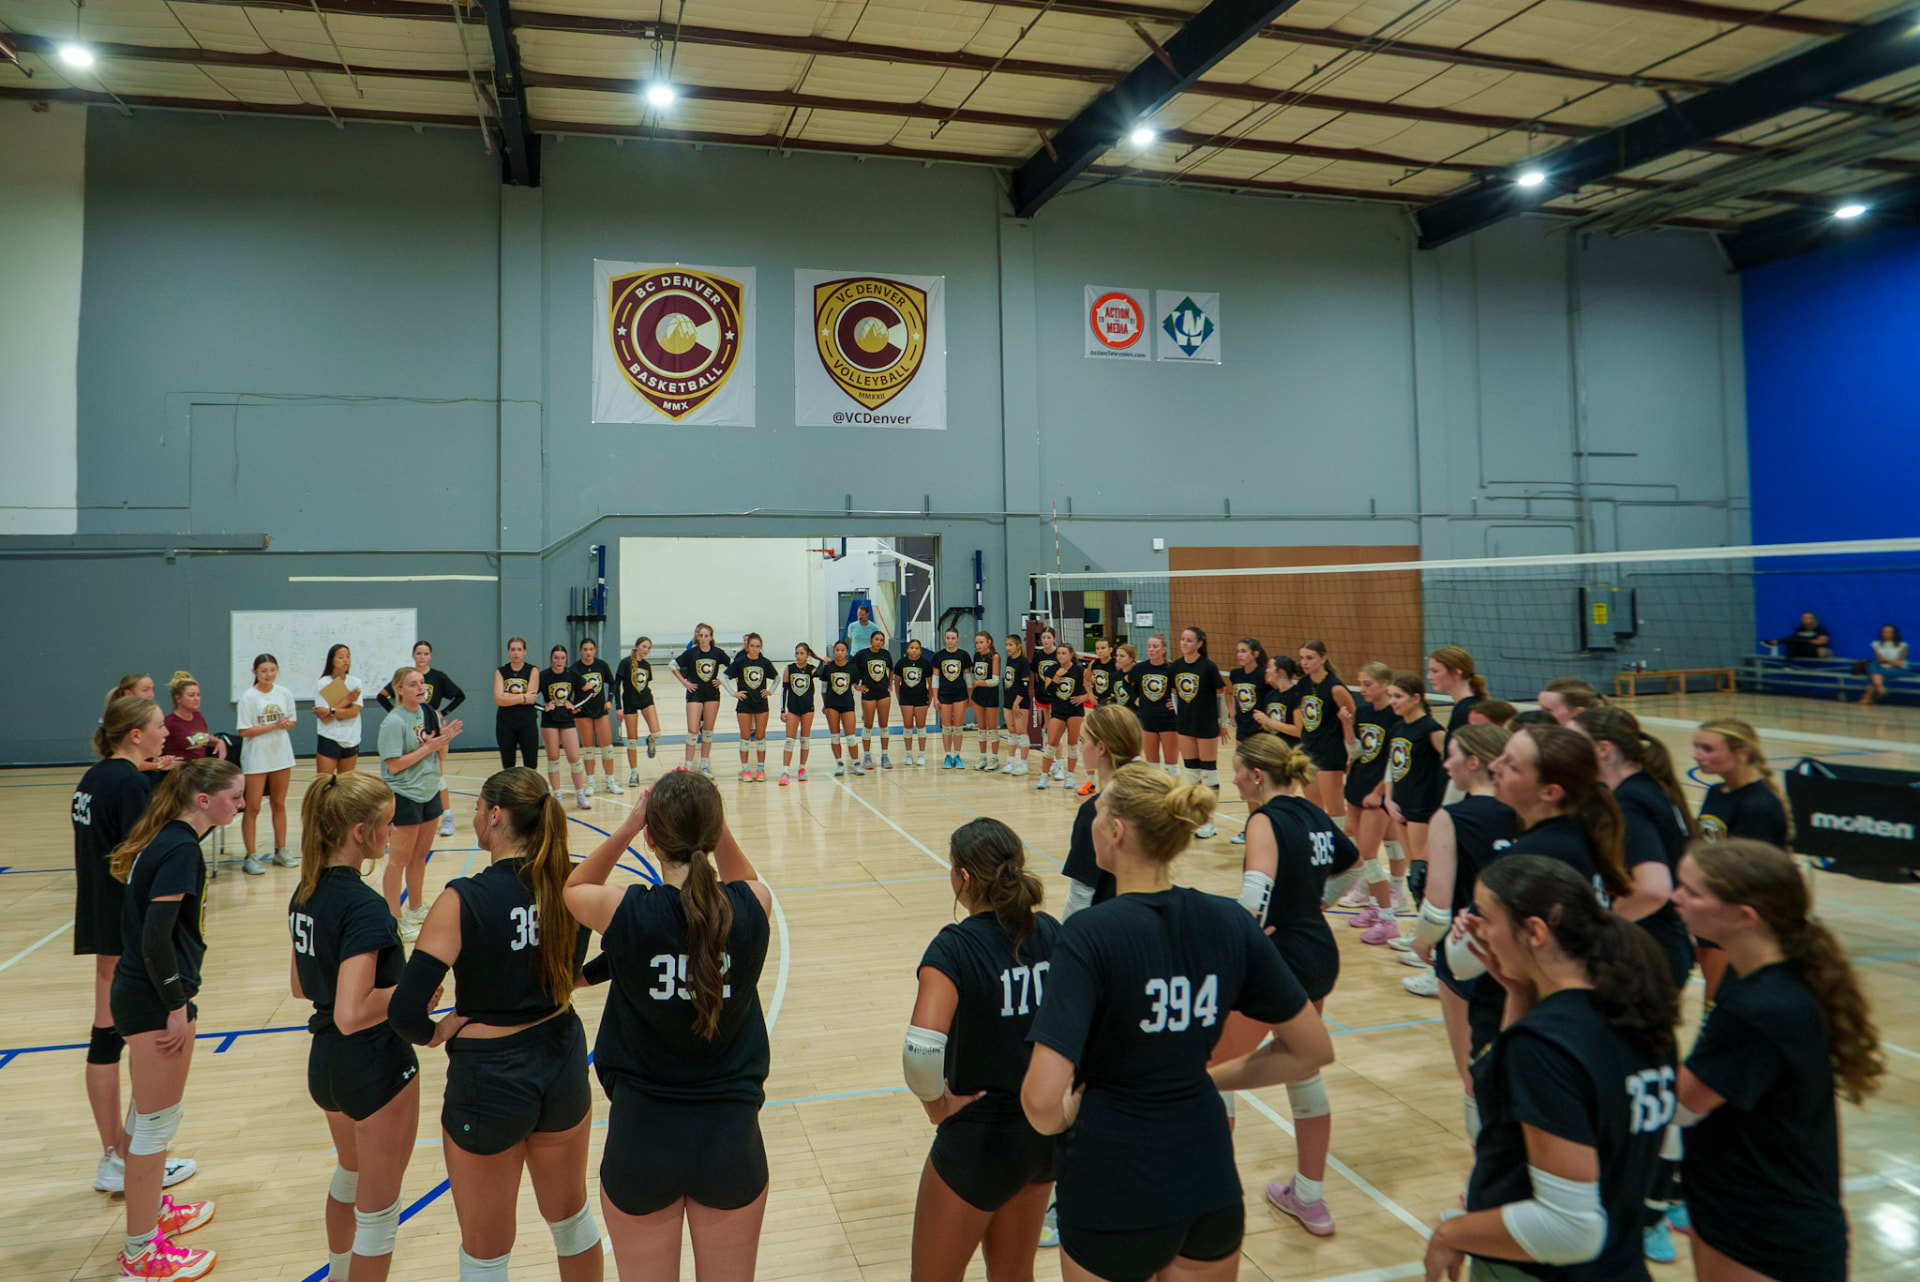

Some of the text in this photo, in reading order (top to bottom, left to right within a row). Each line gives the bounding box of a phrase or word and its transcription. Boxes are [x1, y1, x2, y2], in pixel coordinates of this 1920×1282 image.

[635, 276, 721, 305] BC DENVER
[836, 283, 906, 308] VC DENVER
[1105, 307, 1130, 319] ACTION
[1106, 323, 1129, 334] MEDIA
[629, 363, 723, 393] BASKETBALL
[833, 359, 910, 387] VOLLEYBALL
[663, 401, 689, 411] MMX
[833, 412, 911, 424] @VCDenver
[1810, 812, 1914, 840] molten
[1139, 974, 1218, 1034] 394
